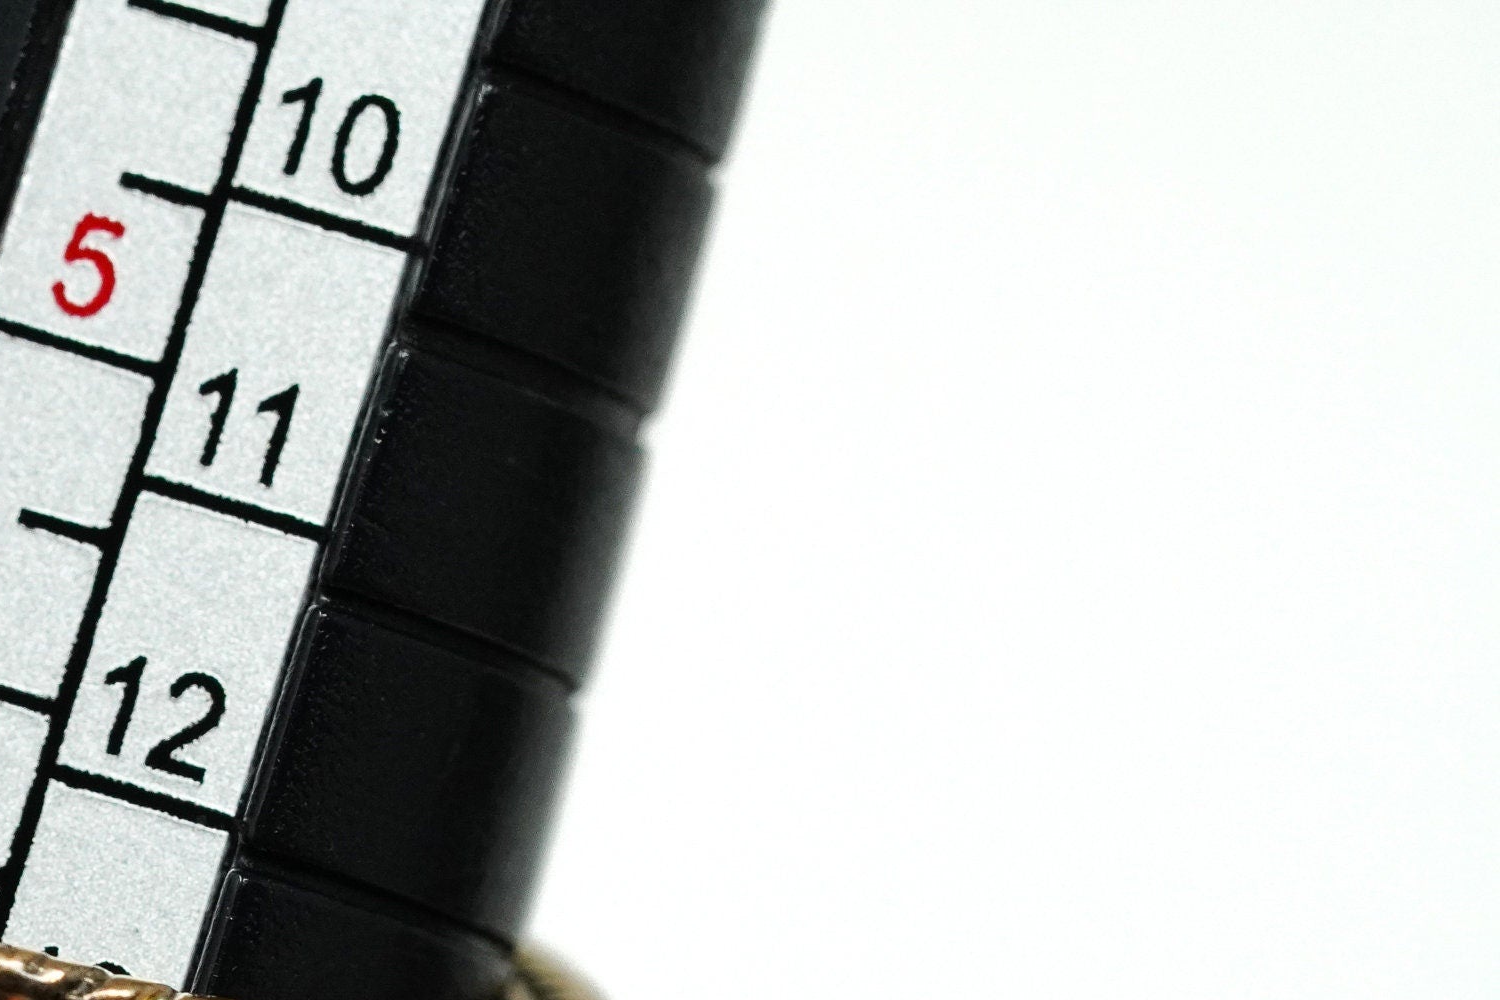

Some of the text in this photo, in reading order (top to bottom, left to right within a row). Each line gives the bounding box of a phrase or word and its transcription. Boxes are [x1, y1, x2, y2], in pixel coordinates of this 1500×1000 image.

[280, 77, 401, 197] 10
[51, 212, 126, 318] 5
[199, 367, 301, 487] 11
[104, 655, 226, 785] 12
